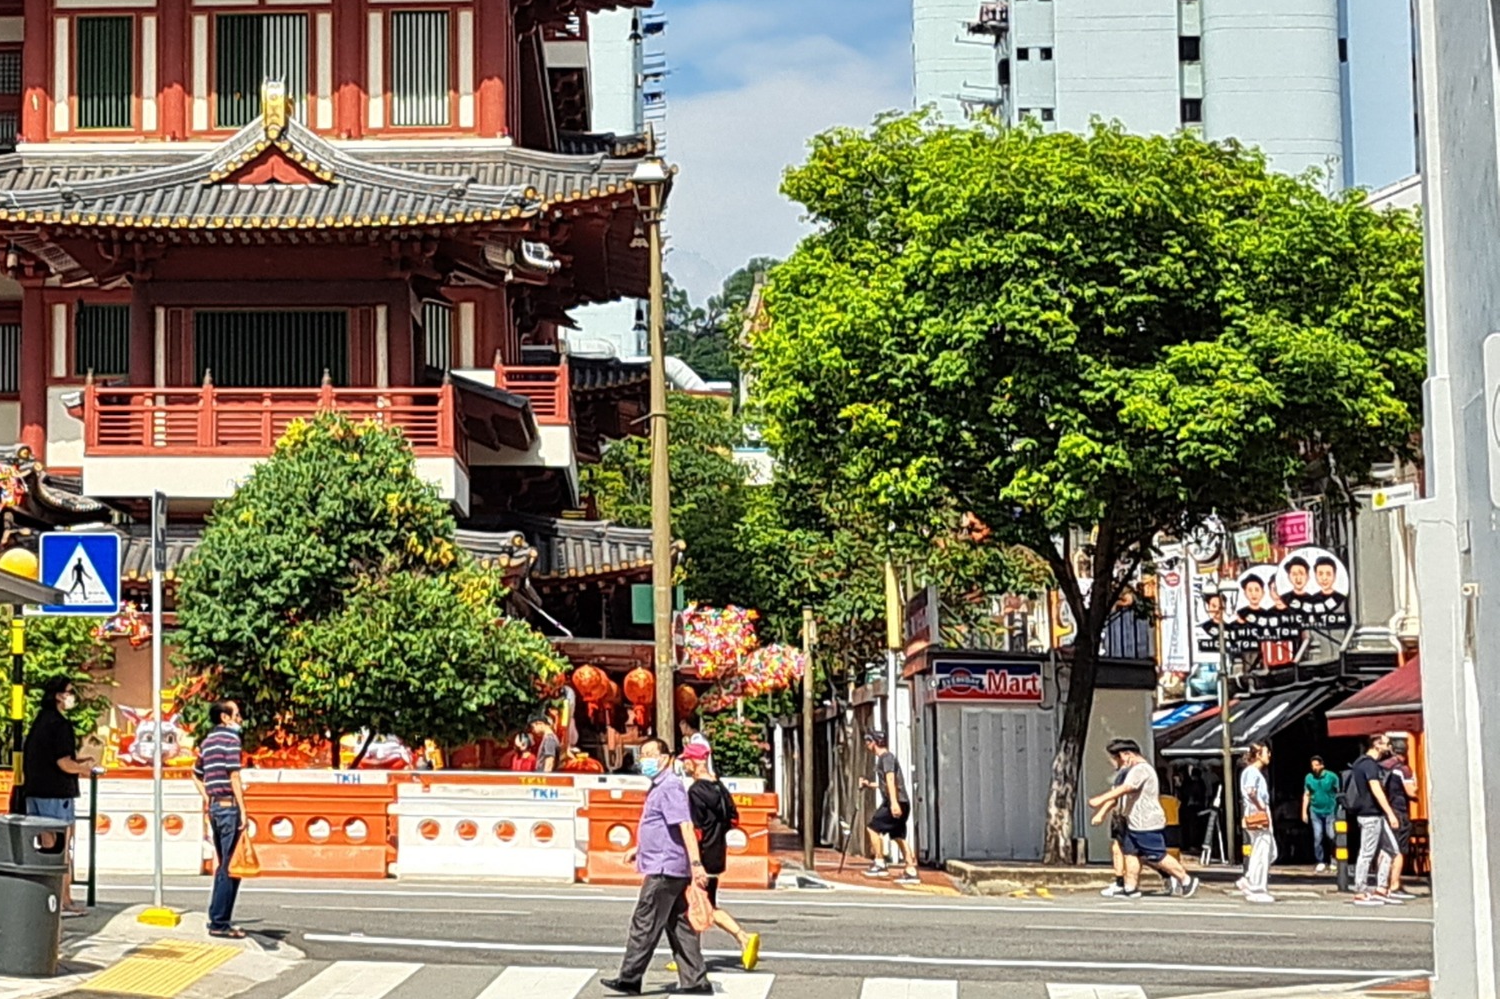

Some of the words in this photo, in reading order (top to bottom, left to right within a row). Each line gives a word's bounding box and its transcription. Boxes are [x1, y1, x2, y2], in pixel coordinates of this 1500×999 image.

[1320, 615, 1347, 623] TOM
[1276, 628, 1299, 636] TOM
[986, 670, 1040, 694] Mart
[334, 773, 361, 784] TKH
[531, 788, 559, 798] TKH
